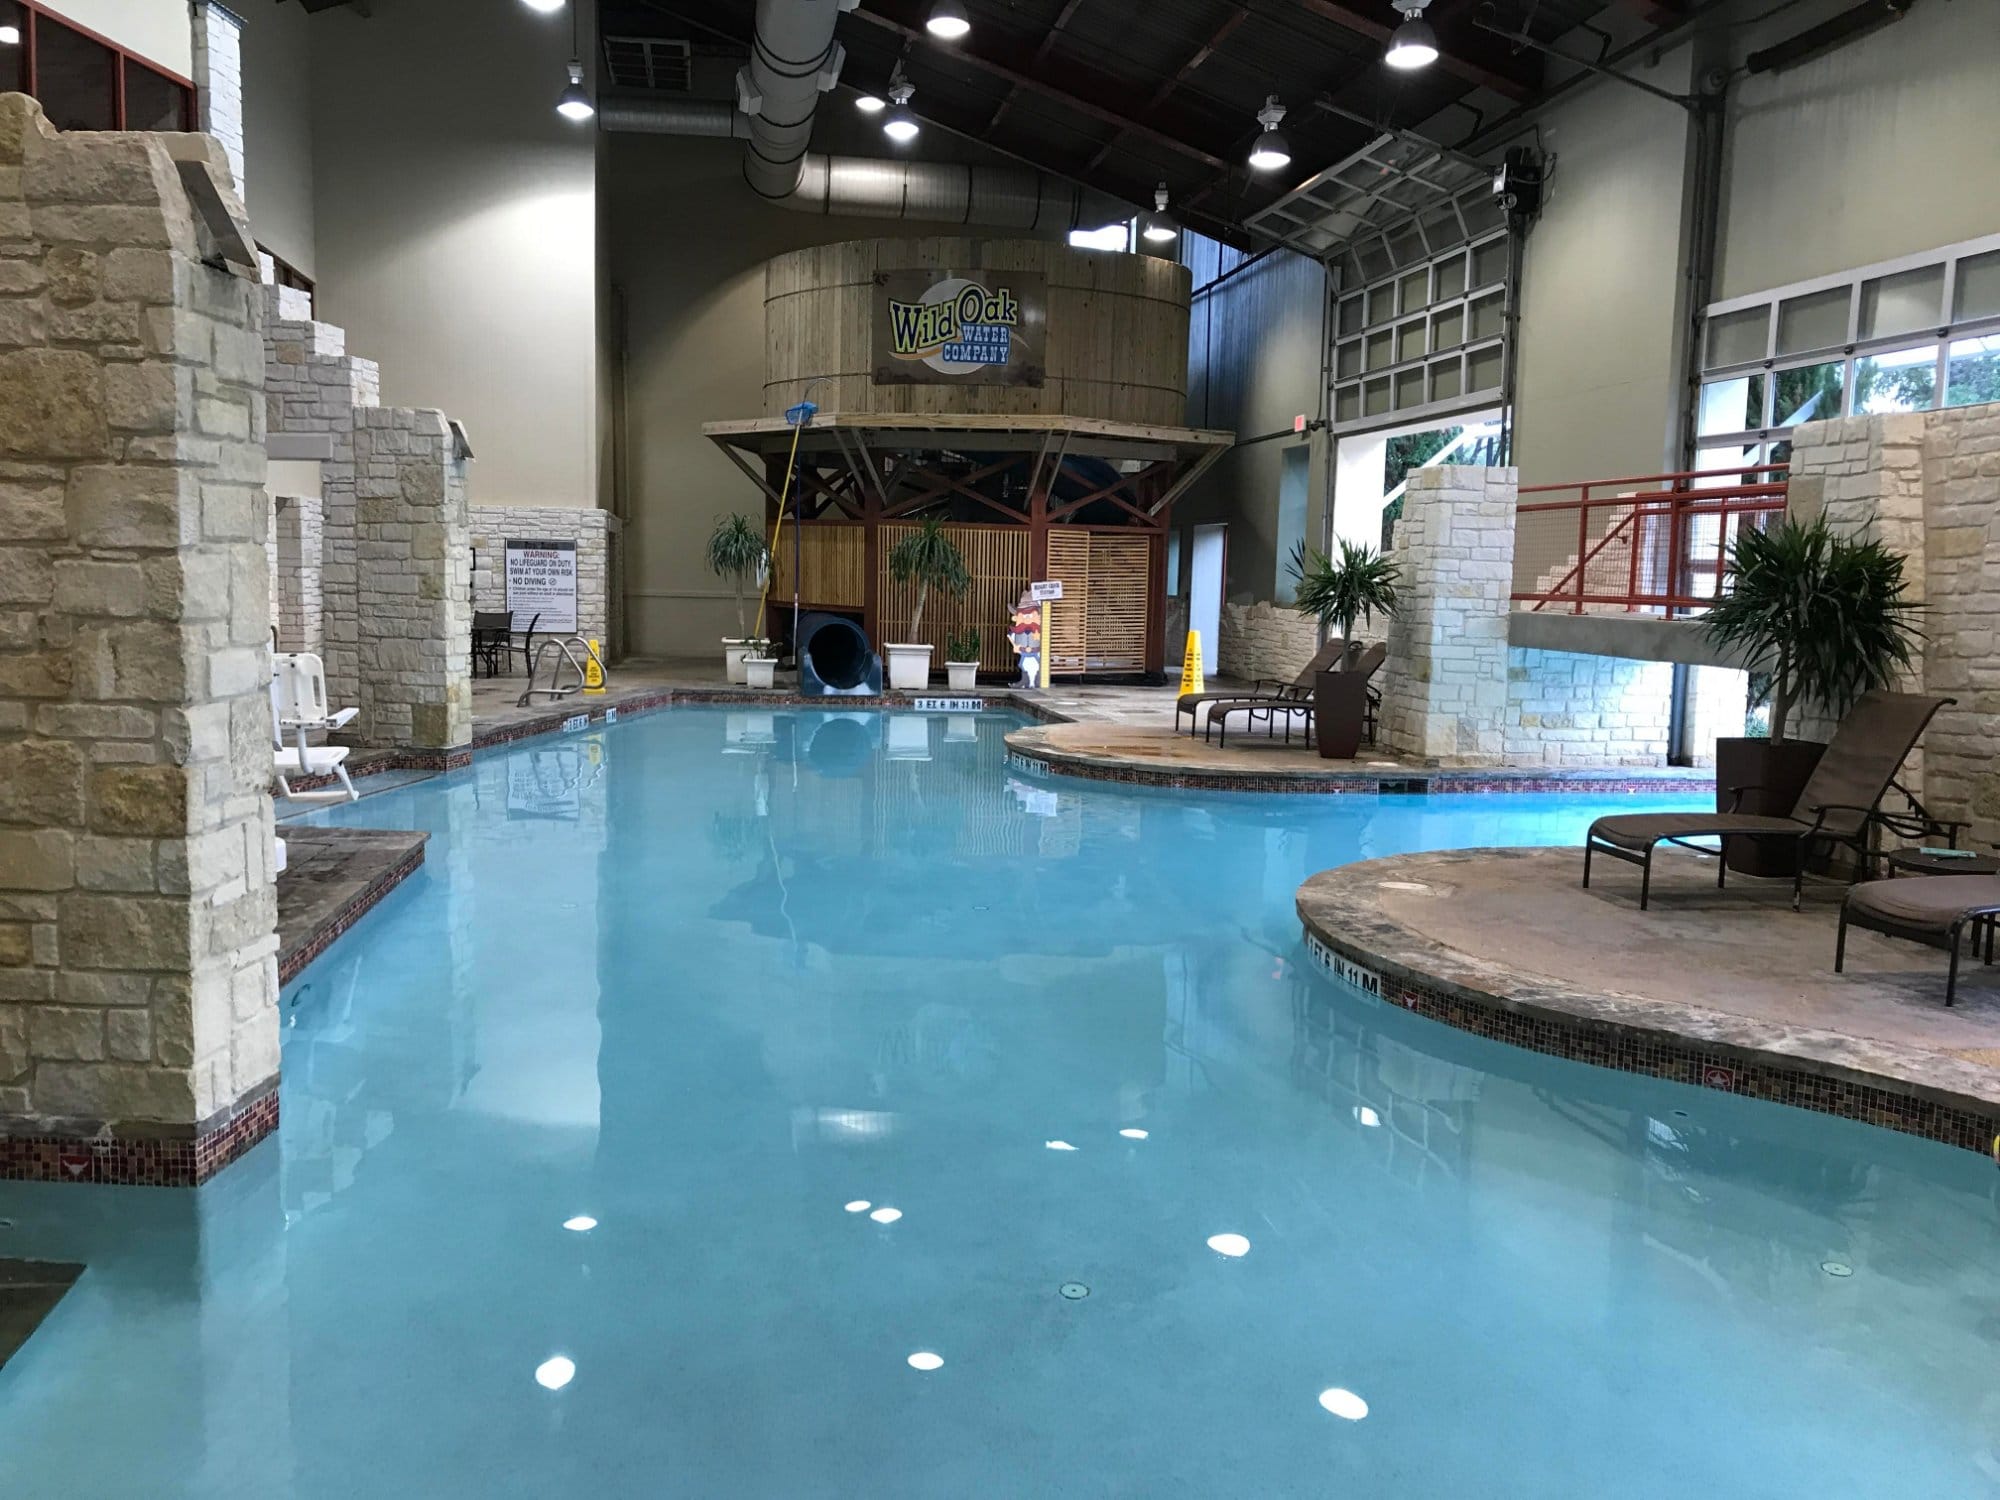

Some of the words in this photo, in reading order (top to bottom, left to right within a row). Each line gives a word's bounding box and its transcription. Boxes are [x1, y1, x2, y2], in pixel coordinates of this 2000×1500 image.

[889, 299, 957, 353] Wild
[956, 284, 1017, 326] Oak
[962, 325, 1008, 343] WATER
[943, 345, 1008, 362] COMPANY
[510, 558, 518, 567] NO
[519, 559, 548, 567] LIFEGUARD
[509, 567, 524, 576] SWIM
[525, 567, 532, 575] AT
[532, 568, 547, 576] YOUR
[548, 568, 560, 576] OWN
[512, 577, 523, 585] NO
[524, 577, 547, 586] DIVING
[1333, 957, 1345, 977] IN
[1362, 972, 1378, 994] M
